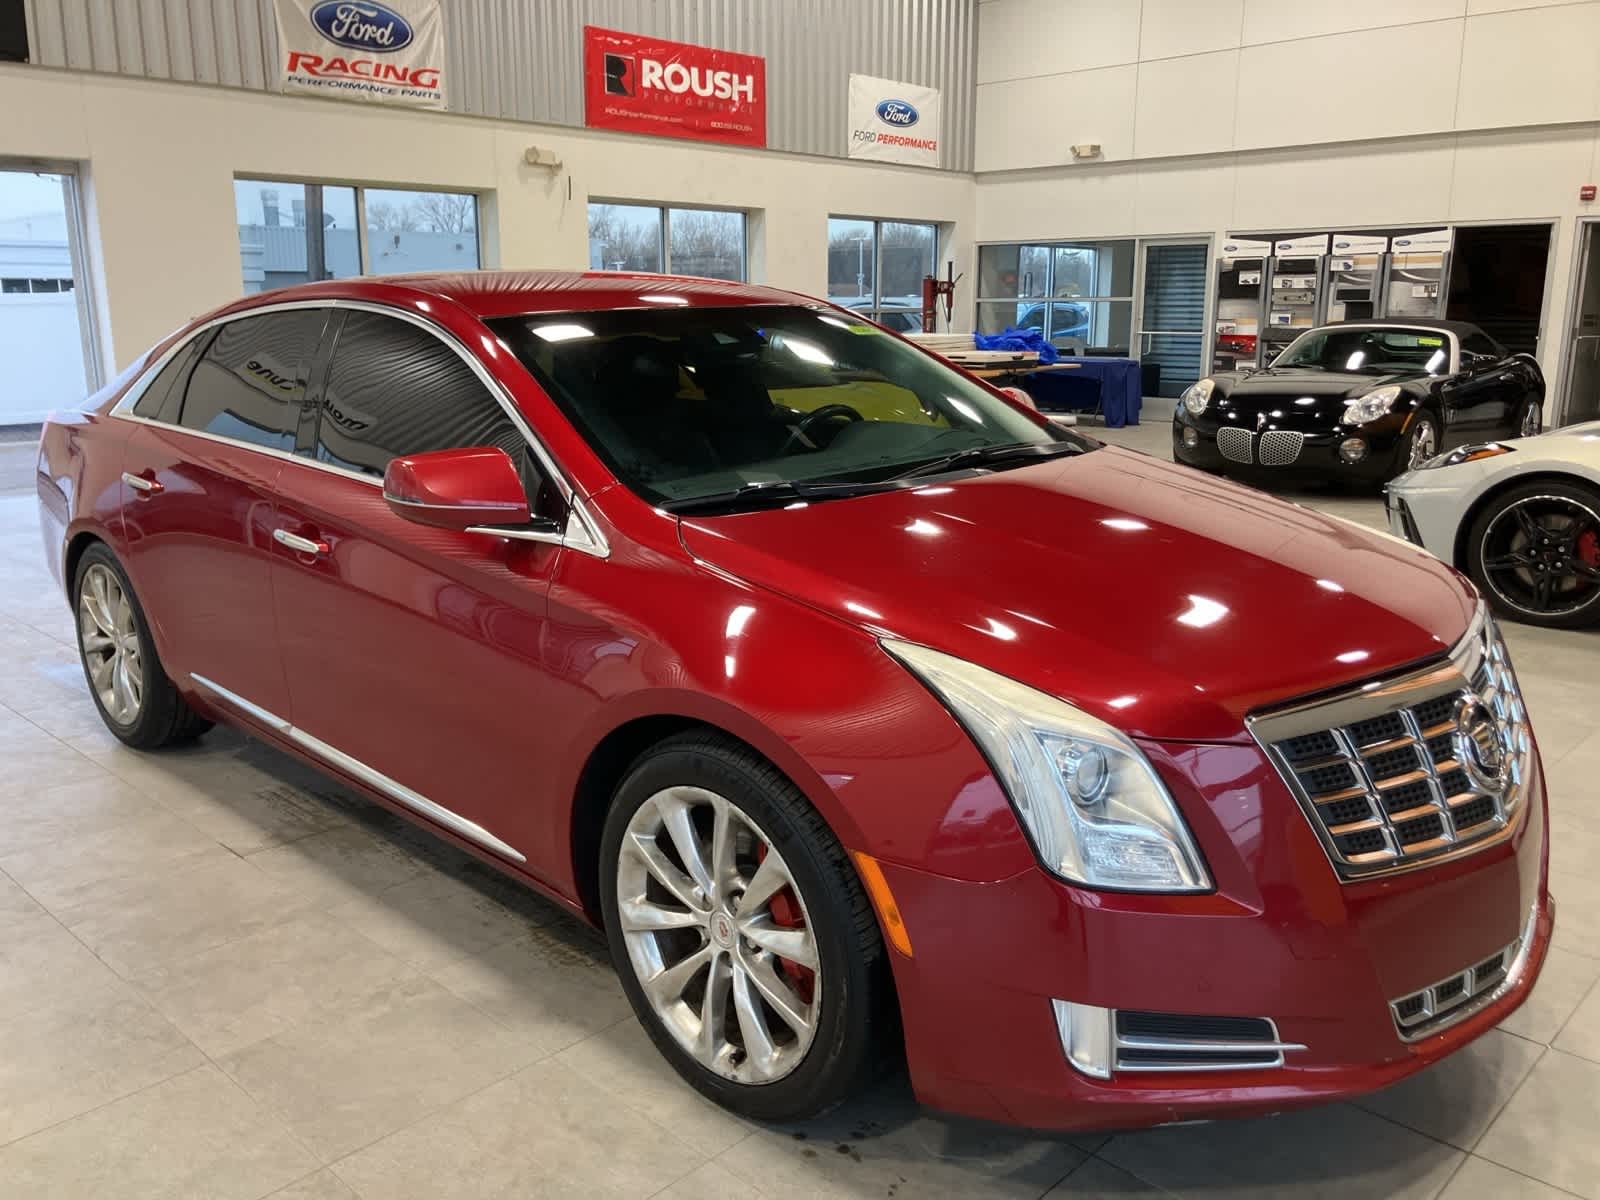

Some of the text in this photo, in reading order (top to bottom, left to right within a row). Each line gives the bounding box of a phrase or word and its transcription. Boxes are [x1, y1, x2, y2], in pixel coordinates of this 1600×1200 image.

[331, 4, 394, 46] Ford
[287, 51, 441, 89] RACING
[641, 58, 754, 103] ROUSH
[287, 75, 441, 100] PERFORMANCE PARTS
[884, 103, 911, 123] Ford
[852, 130, 937, 151] FORD PERFORMANCE
